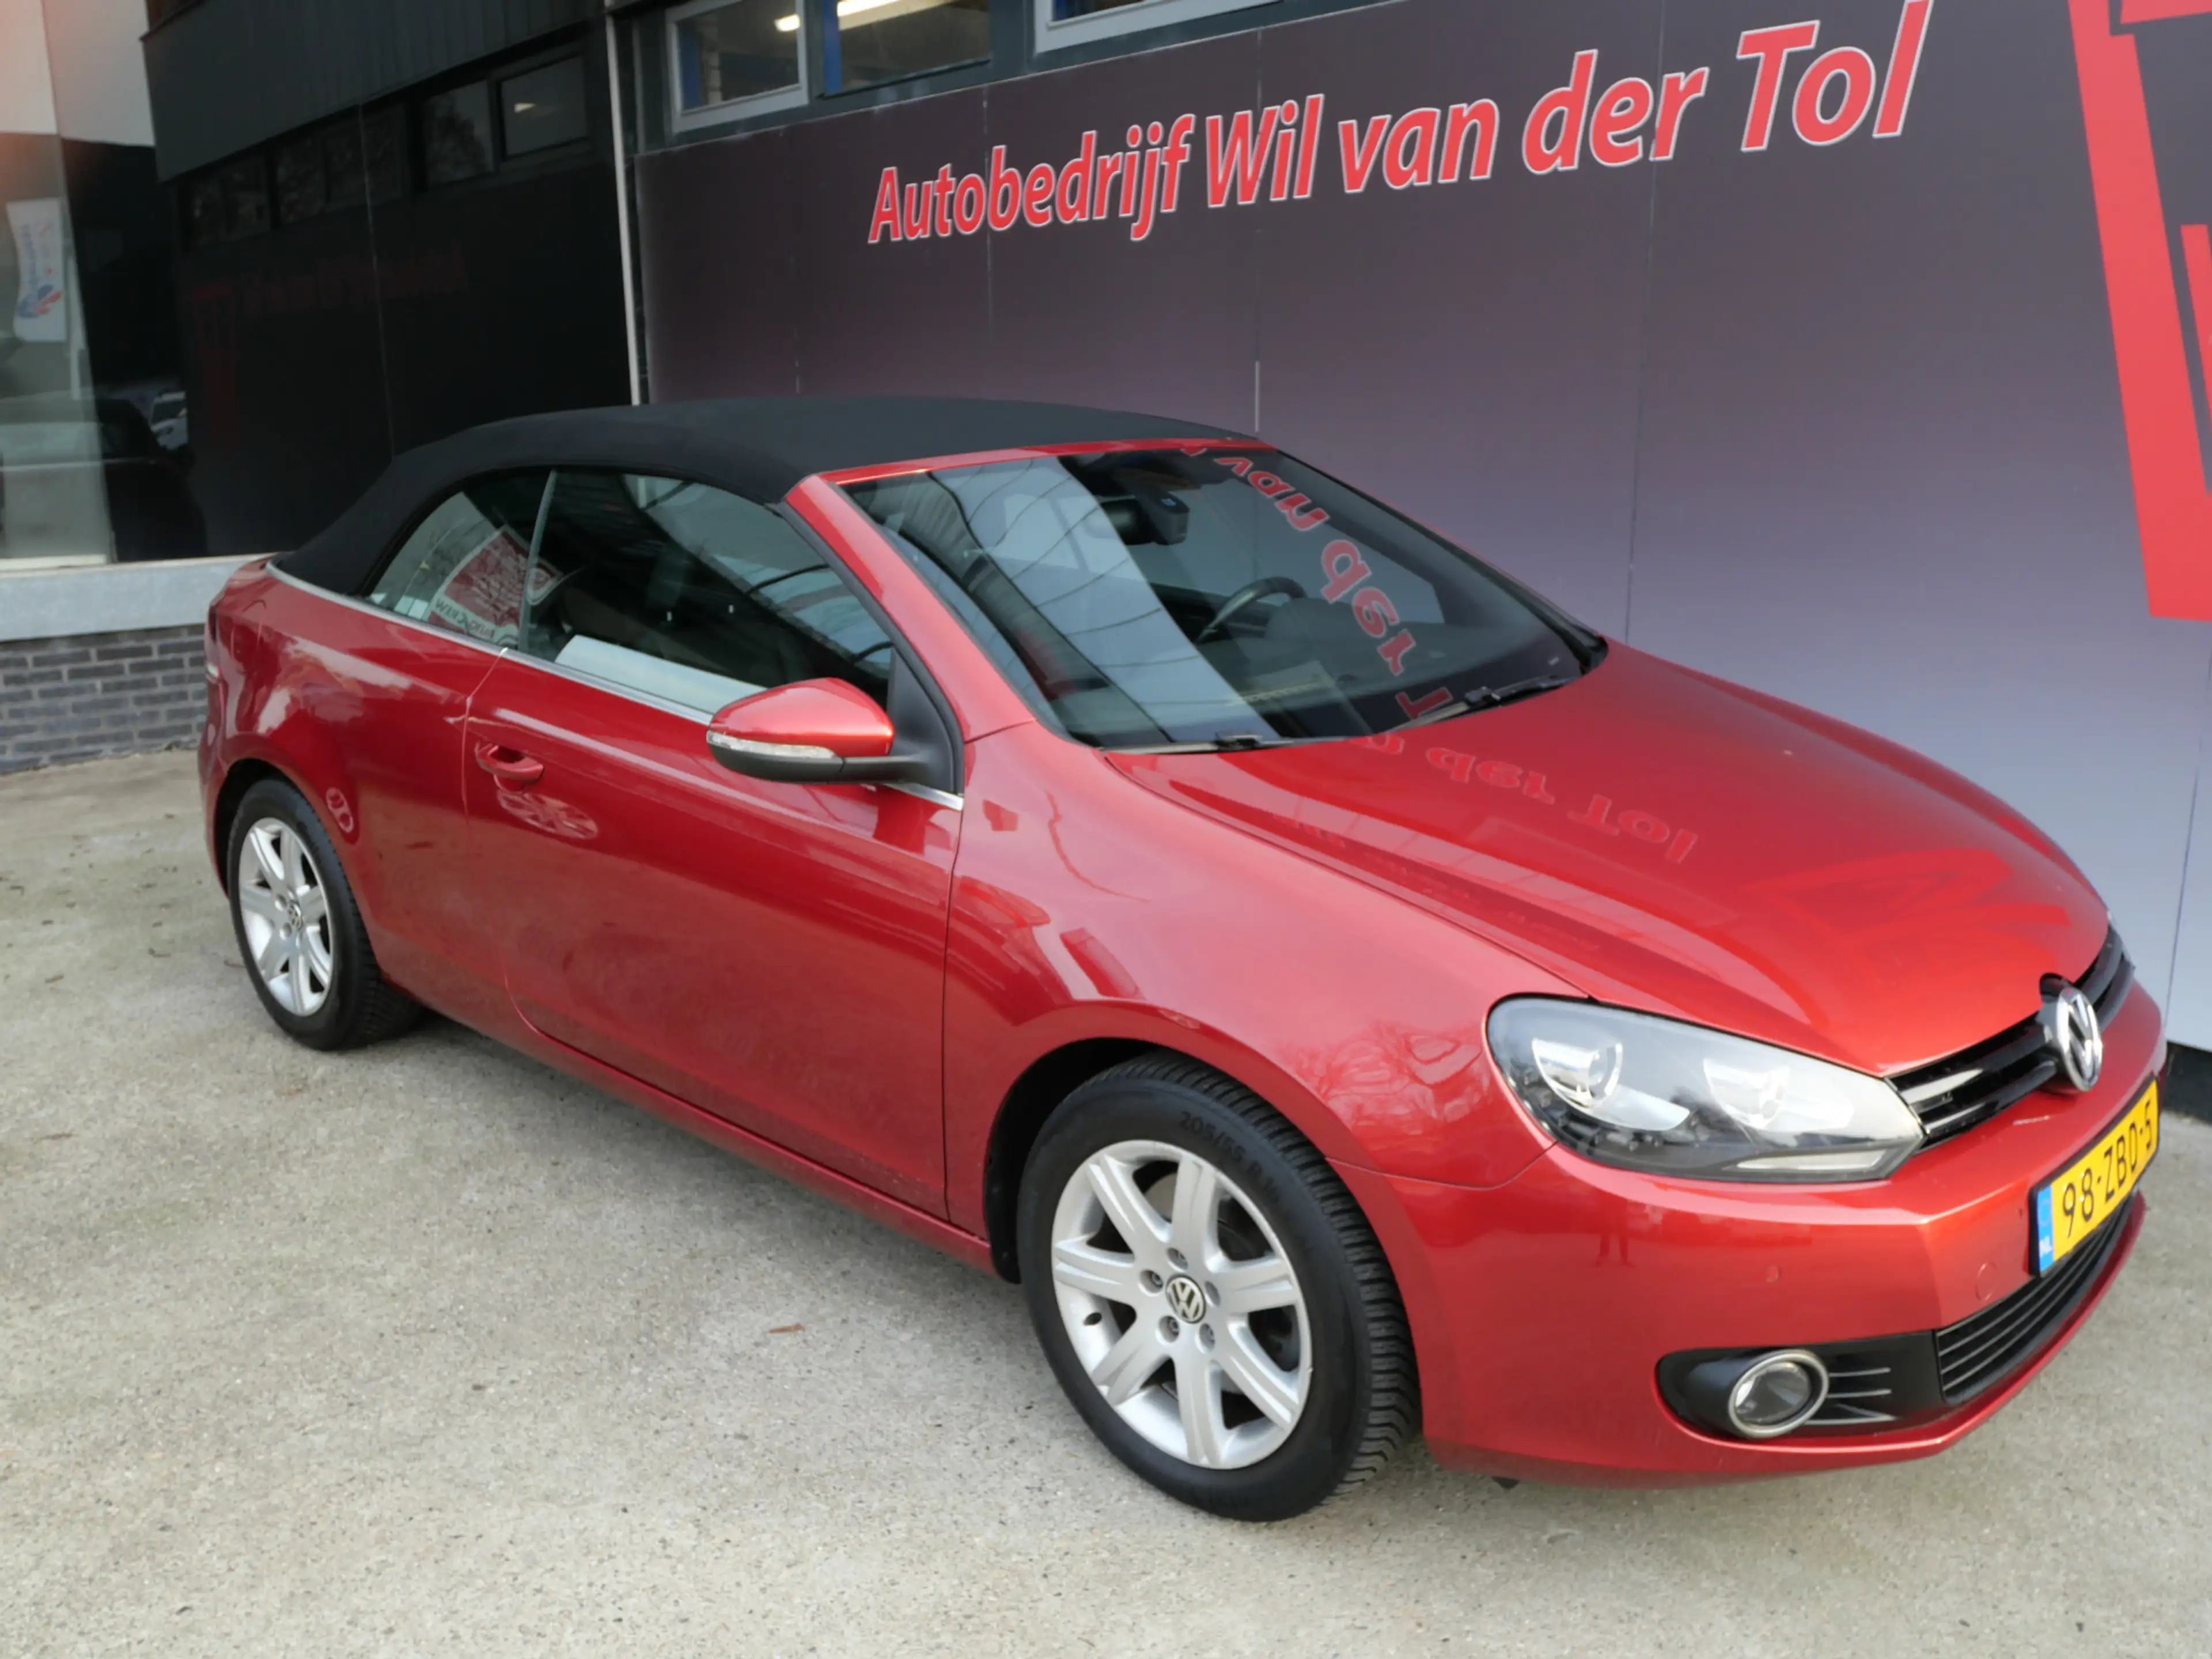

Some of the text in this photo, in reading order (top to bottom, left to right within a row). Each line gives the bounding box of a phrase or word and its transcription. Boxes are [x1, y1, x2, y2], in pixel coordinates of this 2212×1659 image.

[868, 0, 1934, 243] Autobedrijf Wil van der Tol
